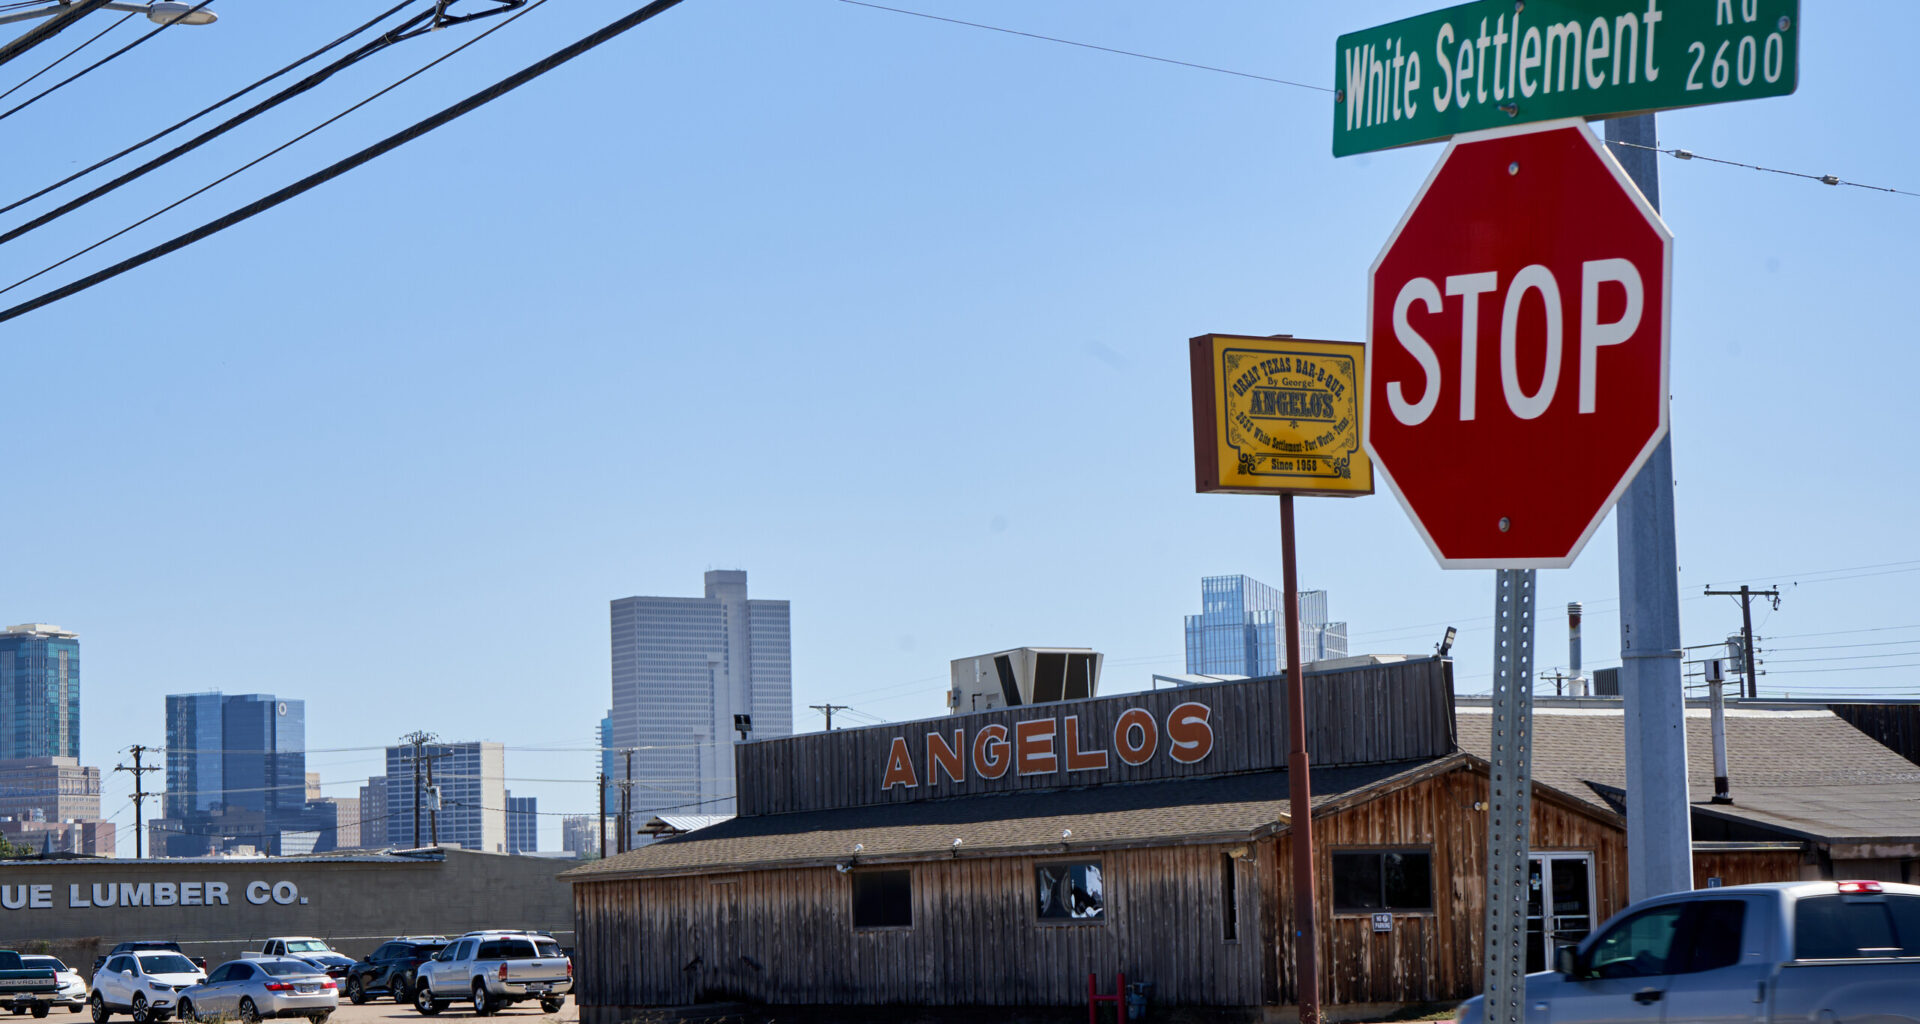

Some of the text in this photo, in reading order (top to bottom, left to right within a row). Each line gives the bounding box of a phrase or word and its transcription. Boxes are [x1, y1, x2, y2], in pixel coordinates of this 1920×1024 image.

[1345, 36, 1421, 131] White
[1433, 0, 1663, 112] Settlement
[1685, 32, 1784, 91] 2600
[1386, 257, 1644, 426] STOP
[1232, 365, 1261, 397] GREAT
[1260, 357, 1291, 377] TEXAS
[1268, 377, 1315, 388] By George!
[1249, 390, 1334, 418] ANGELO'S
[1254, 426, 1271, 446] White
[1332, 417, 1349, 435] Texas
[1271, 458, 1317, 471] Since 1958
[881, 701, 1214, 790] ANGELOS
[0, 880, 309, 909] UE LUMBER CO.
